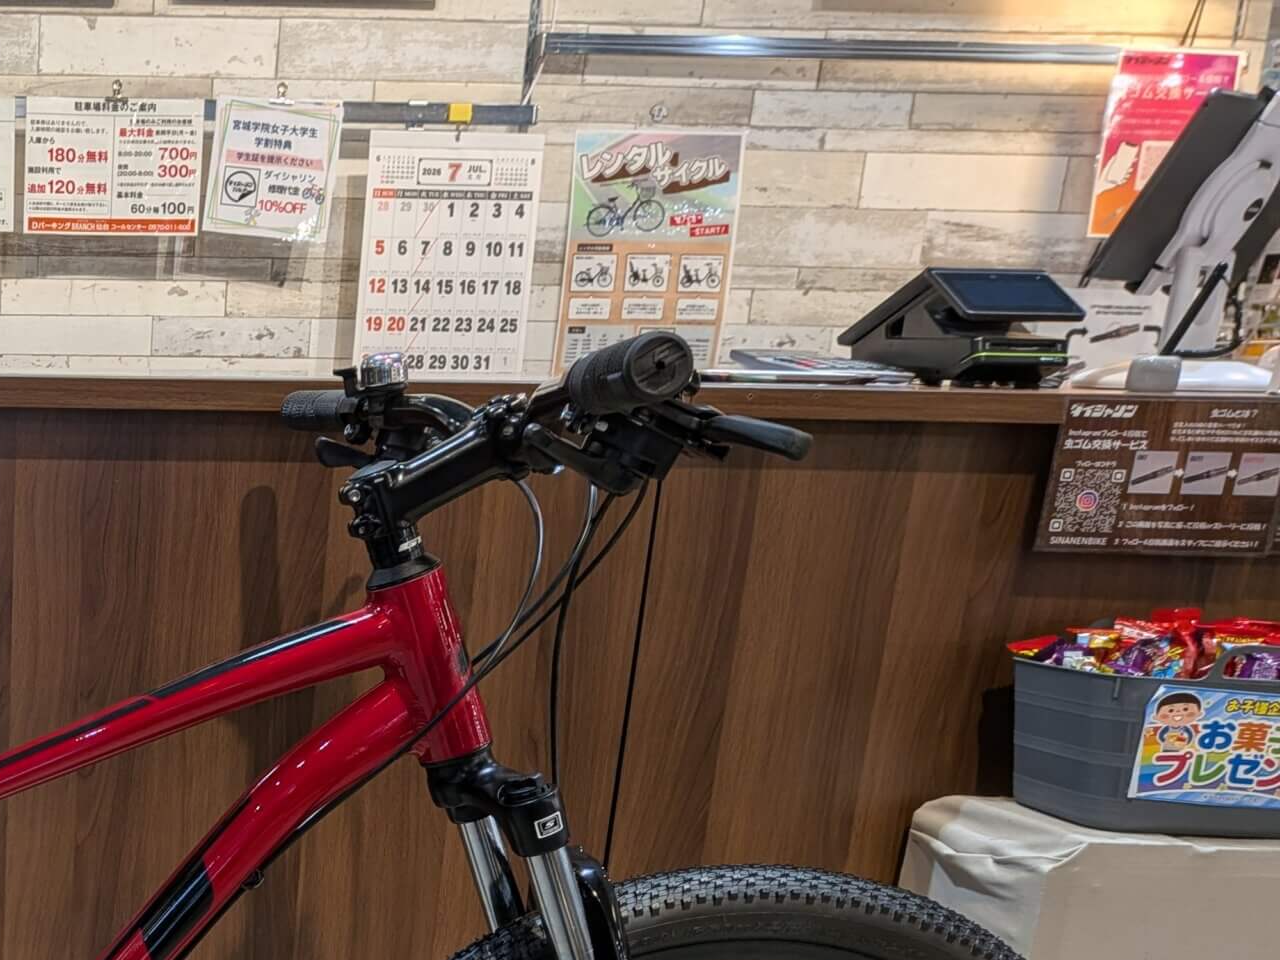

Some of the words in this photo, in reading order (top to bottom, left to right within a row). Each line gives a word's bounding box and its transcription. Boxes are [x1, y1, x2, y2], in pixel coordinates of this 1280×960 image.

[74, 102, 156, 112] 駐車場料金のご案内
[120, 128, 154, 138] 最大料金
[233, 120, 319, 138] 宮城学院女子大学生
[254, 137, 292, 150] 学割特典
[580, 142, 670, 180] レンタル
[448, 163, 462, 182] 7
[653, 157, 728, 187] サイクル
[258, 200, 307, 214] 10%OFF
[377, 203, 389, 211] 28
[400, 203, 411, 211] 29
[448, 203, 455, 217] 1
[470, 203, 479, 218] 2
[492, 203, 502, 218] 3
[515, 203, 524, 218] 4
[375, 240, 384, 255] 5
[397, 240, 407, 255] 6
[420, 241, 430, 256] 7
[443, 241, 453, 256] 8
[465, 241, 475, 256] 9
[486, 242, 502, 257] 10
[508, 242, 524, 257] 11
[369, 278, 385, 293] 12
[391, 279, 407, 294] 13
[414, 279, 430, 294] 14
[436, 280, 453, 294] 15
[459, 280, 476, 295] 16
[482, 280, 498, 295] 17
[504, 280, 521, 295] 18
[366, 316, 382, 331] 19
[387, 317, 405, 332] 20
[410, 317, 426, 332] 21
[432, 317, 450, 332] 22
[455, 317, 472, 333] 23
[477, 317, 495, 333] 24
[500, 318, 517, 333] 25
[407, 354, 424, 369] 28
[428, 354, 446, 369] 29
[451, 354, 469, 369] 30
[473, 355, 491, 370] 31
